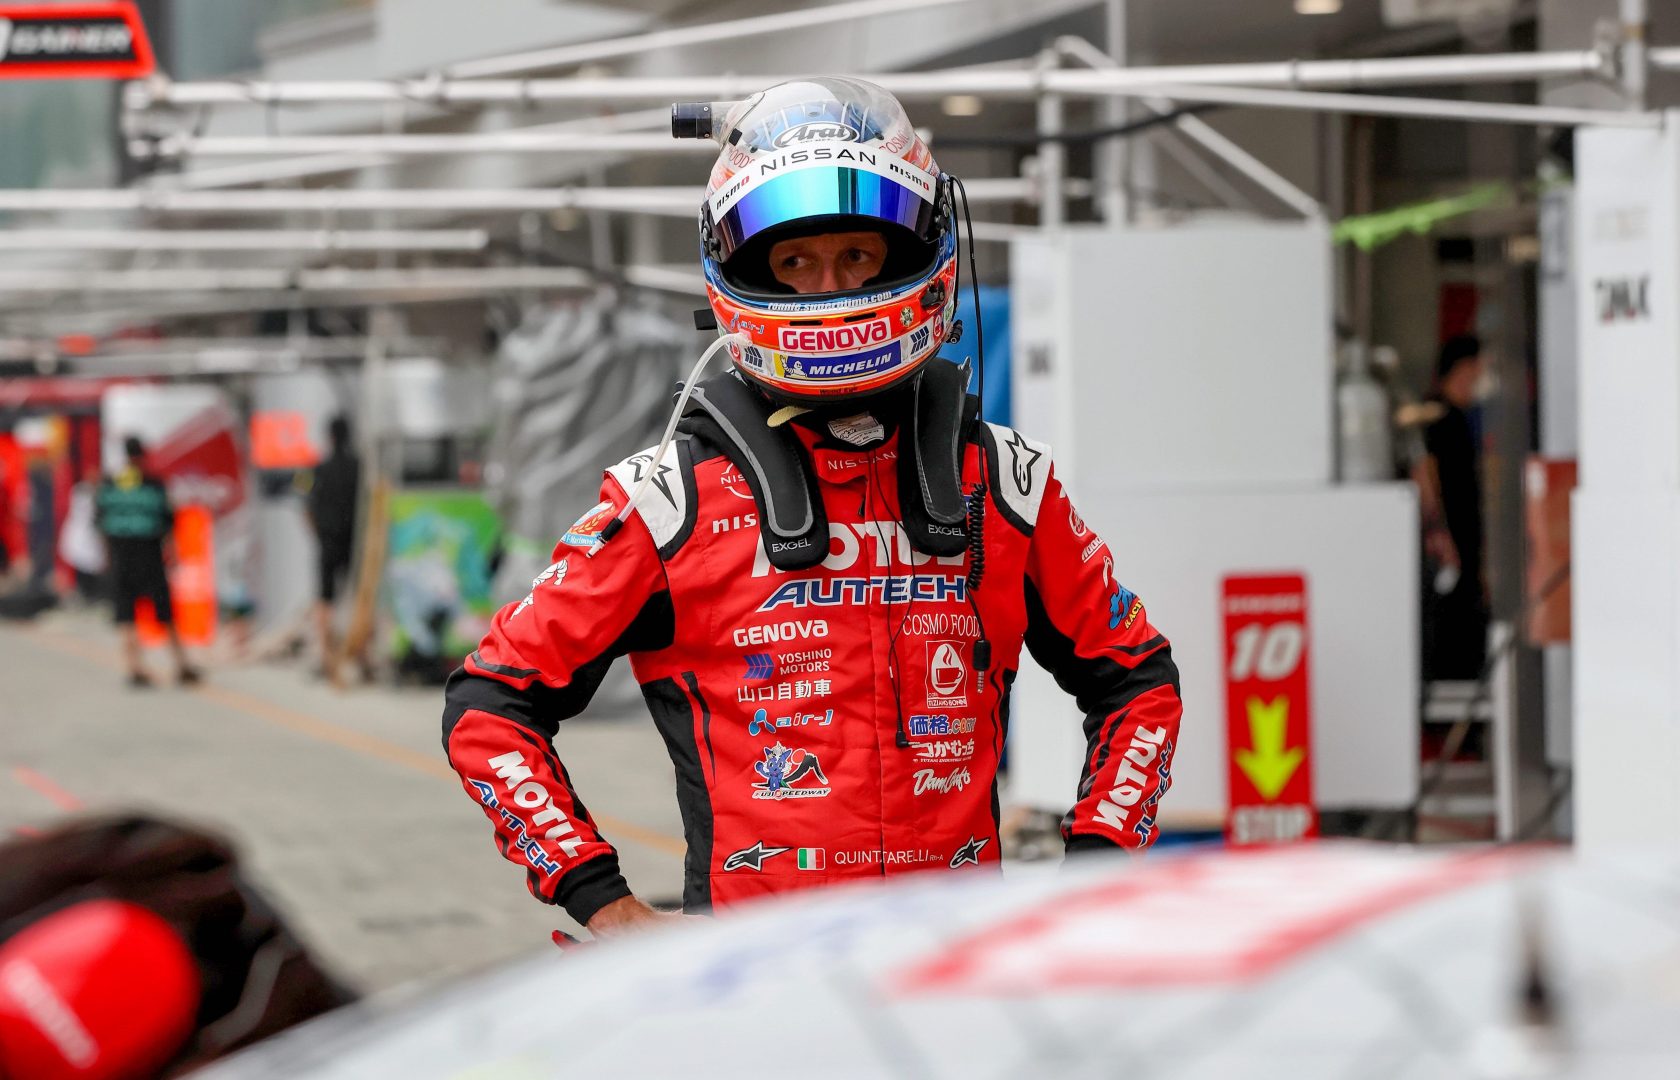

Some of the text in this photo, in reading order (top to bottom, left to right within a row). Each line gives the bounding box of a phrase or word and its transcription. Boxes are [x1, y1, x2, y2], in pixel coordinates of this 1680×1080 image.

[781, 124, 848, 145] Arai
[760, 148, 877, 176] NISSAN
[889, 163, 930, 191] nismo
[716, 175, 750, 210] nismo
[809, 352, 892, 375] MICHELIN
[720, 473, 746, 485] NIS
[712, 513, 757, 534] nis
[927, 523, 966, 537] EXGEL
[772, 540, 812, 553] EXGEL
[755, 575, 967, 613] AUTECH
[903, 613, 949, 636] COSMO
[778, 649, 833, 665] YOSHINO
[1230, 621, 1304, 682] 10
[779, 660, 830, 675] MOTORS
[737, 678, 832, 703] 山口自動車
[1092, 725, 1167, 832] MOTUL
[487, 750, 592, 859] MOTUL
